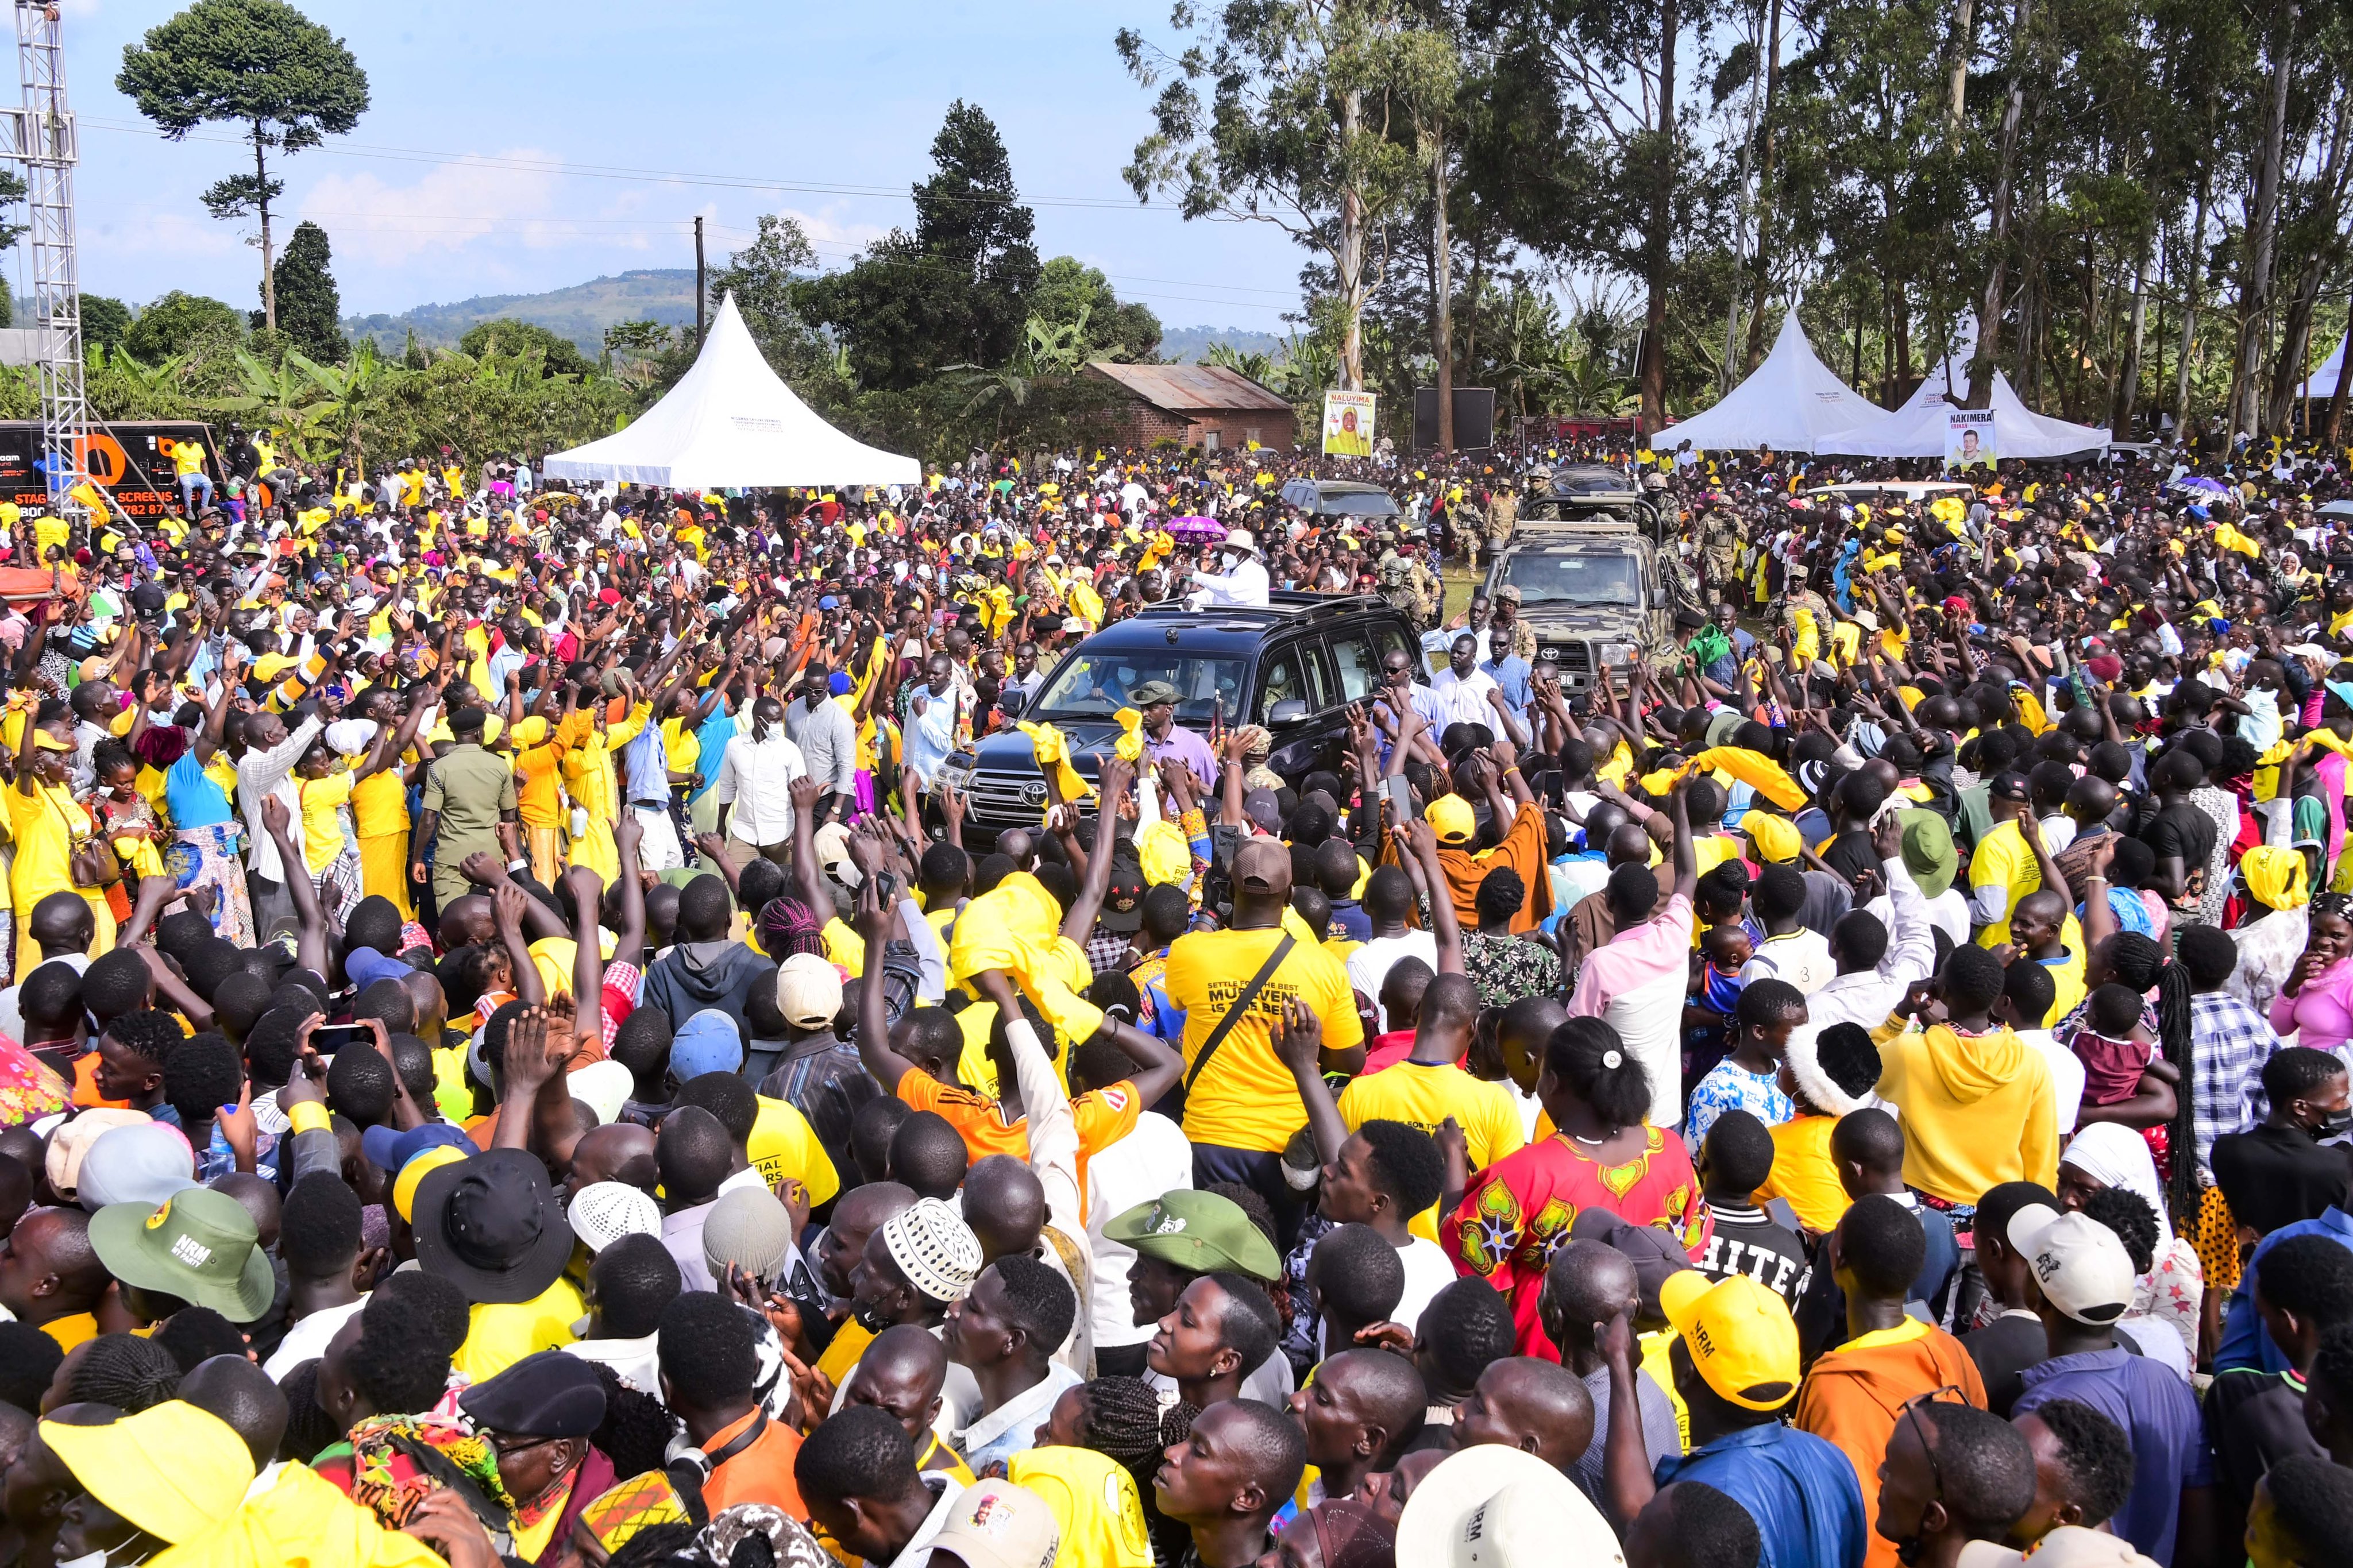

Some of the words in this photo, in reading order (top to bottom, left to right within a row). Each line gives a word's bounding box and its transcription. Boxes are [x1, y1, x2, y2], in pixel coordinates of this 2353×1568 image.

[1331, 395, 1370, 403] NALUYIMA
[1950, 413, 1992, 423] NAKIMERA
[1558, 674, 1573, 685] 80
[1174, 868, 1189, 876] PRE
[1172, 876, 1184, 884] ZO
[1208, 980, 1238, 989] SETTLE
[1278, 983, 1299, 991] BEST
[1211, 1003, 1226, 1013] IS
[763, 1171, 784, 1183] RS
[175, 1233, 212, 1262] NRM
[171, 1245, 183, 1257] MY
[179, 1252, 203, 1268] PARTY
[1692, 1235, 1797, 1296] HITE
[1695, 1319, 1715, 1358] NRM
